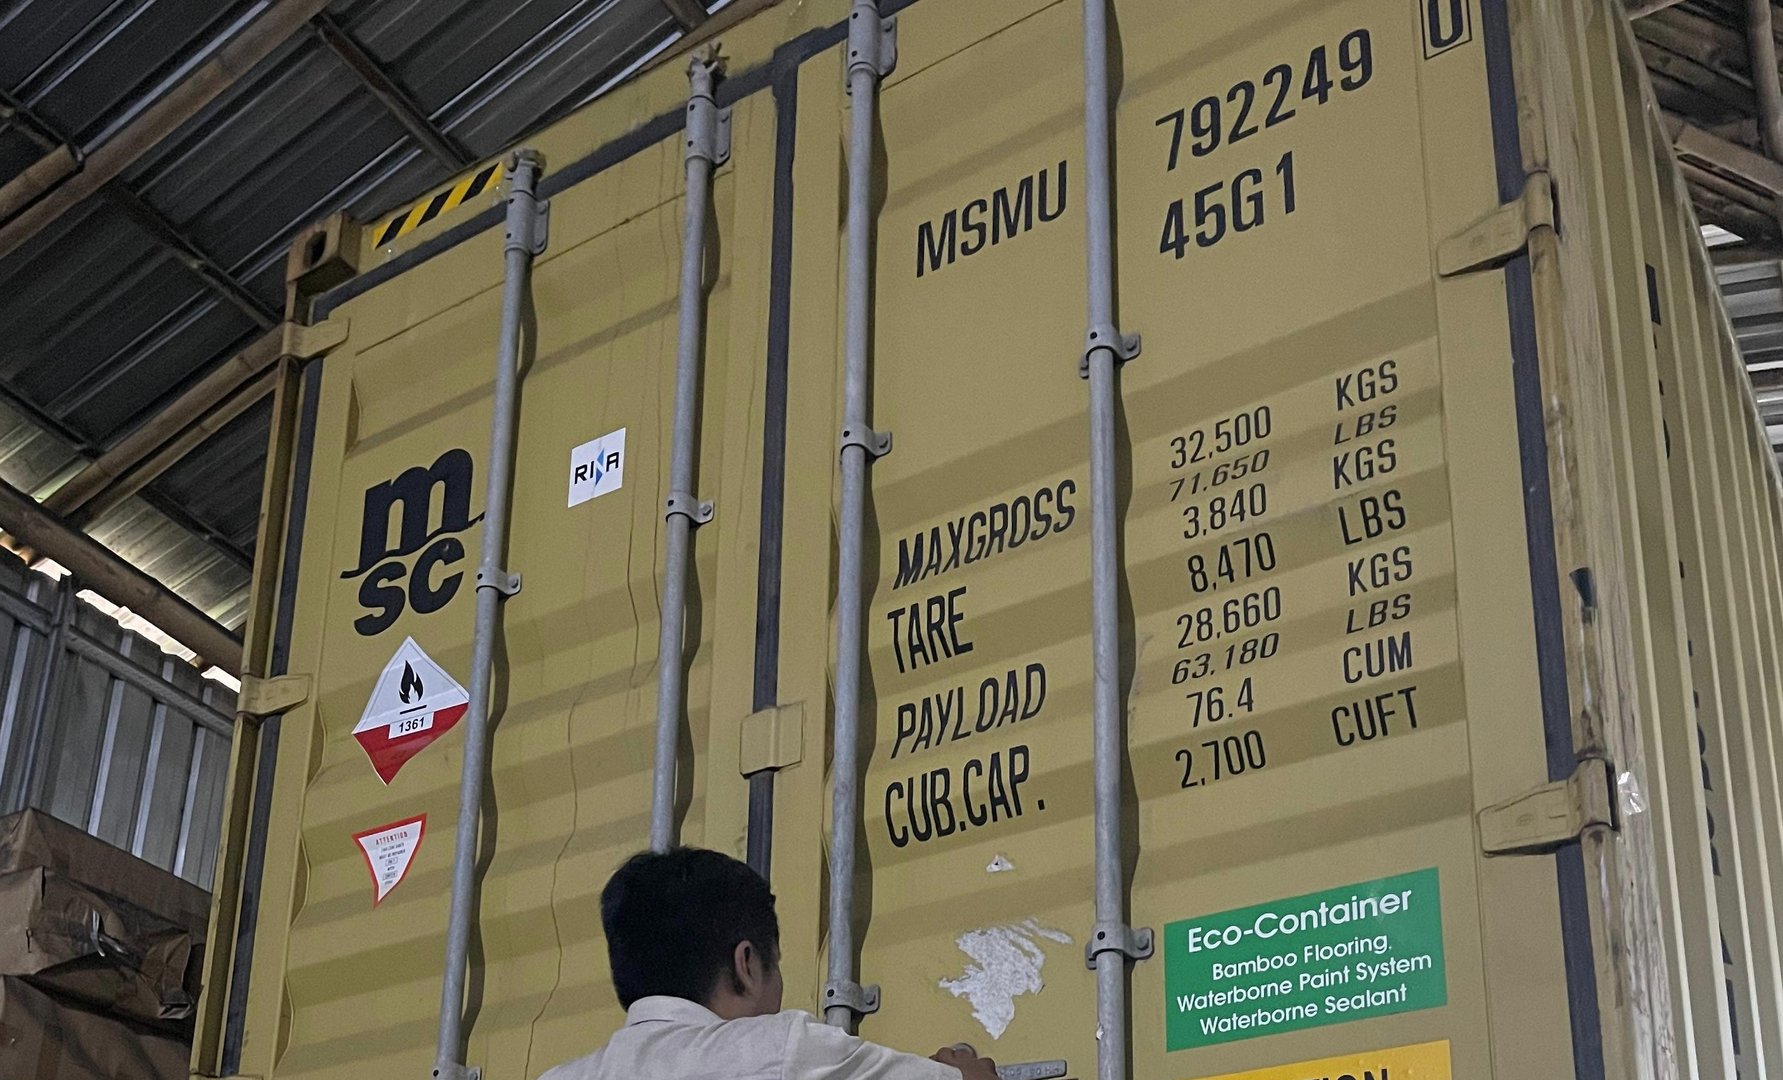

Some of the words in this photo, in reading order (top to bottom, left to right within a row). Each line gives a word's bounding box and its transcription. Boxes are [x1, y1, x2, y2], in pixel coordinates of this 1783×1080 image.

[1155, 28, 1374, 172] 792249
[915, 160, 1068, 278] MSMU
[1160, 151, 1297, 260] 45G1
[1335, 359, 1398, 411] KGS
[1334, 405, 1397, 445] LBS
[1333, 438, 1397, 490] KGS
[892, 479, 1077, 590] MAXGROSS
[1337, 489, 1406, 545] LBS
[1348, 545, 1413, 596] KGS
[887, 586, 974, 673] TARE
[1346, 593, 1411, 635] LBS
[1186, 678, 1255, 728] 76.4
[1343, 631, 1413, 684] CUM
[398, 716, 425, 733] 1361
[890, 662, 1047, 759] PAYLOAD
[1331, 686, 1418, 747] CUFT
[375, 831, 408, 846] ATTENTION
[1188, 888, 1412, 953] Eco-Container
[1176, 980, 1293, 1013] Waterborne
[1300, 967, 1350, 992] Paint
[1356, 954, 1432, 985] System
[1212, 951, 1298, 981] Bamboo
[1199, 1002, 1319, 1036] Waterborne
[1324, 983, 1407, 1015] Sealant
